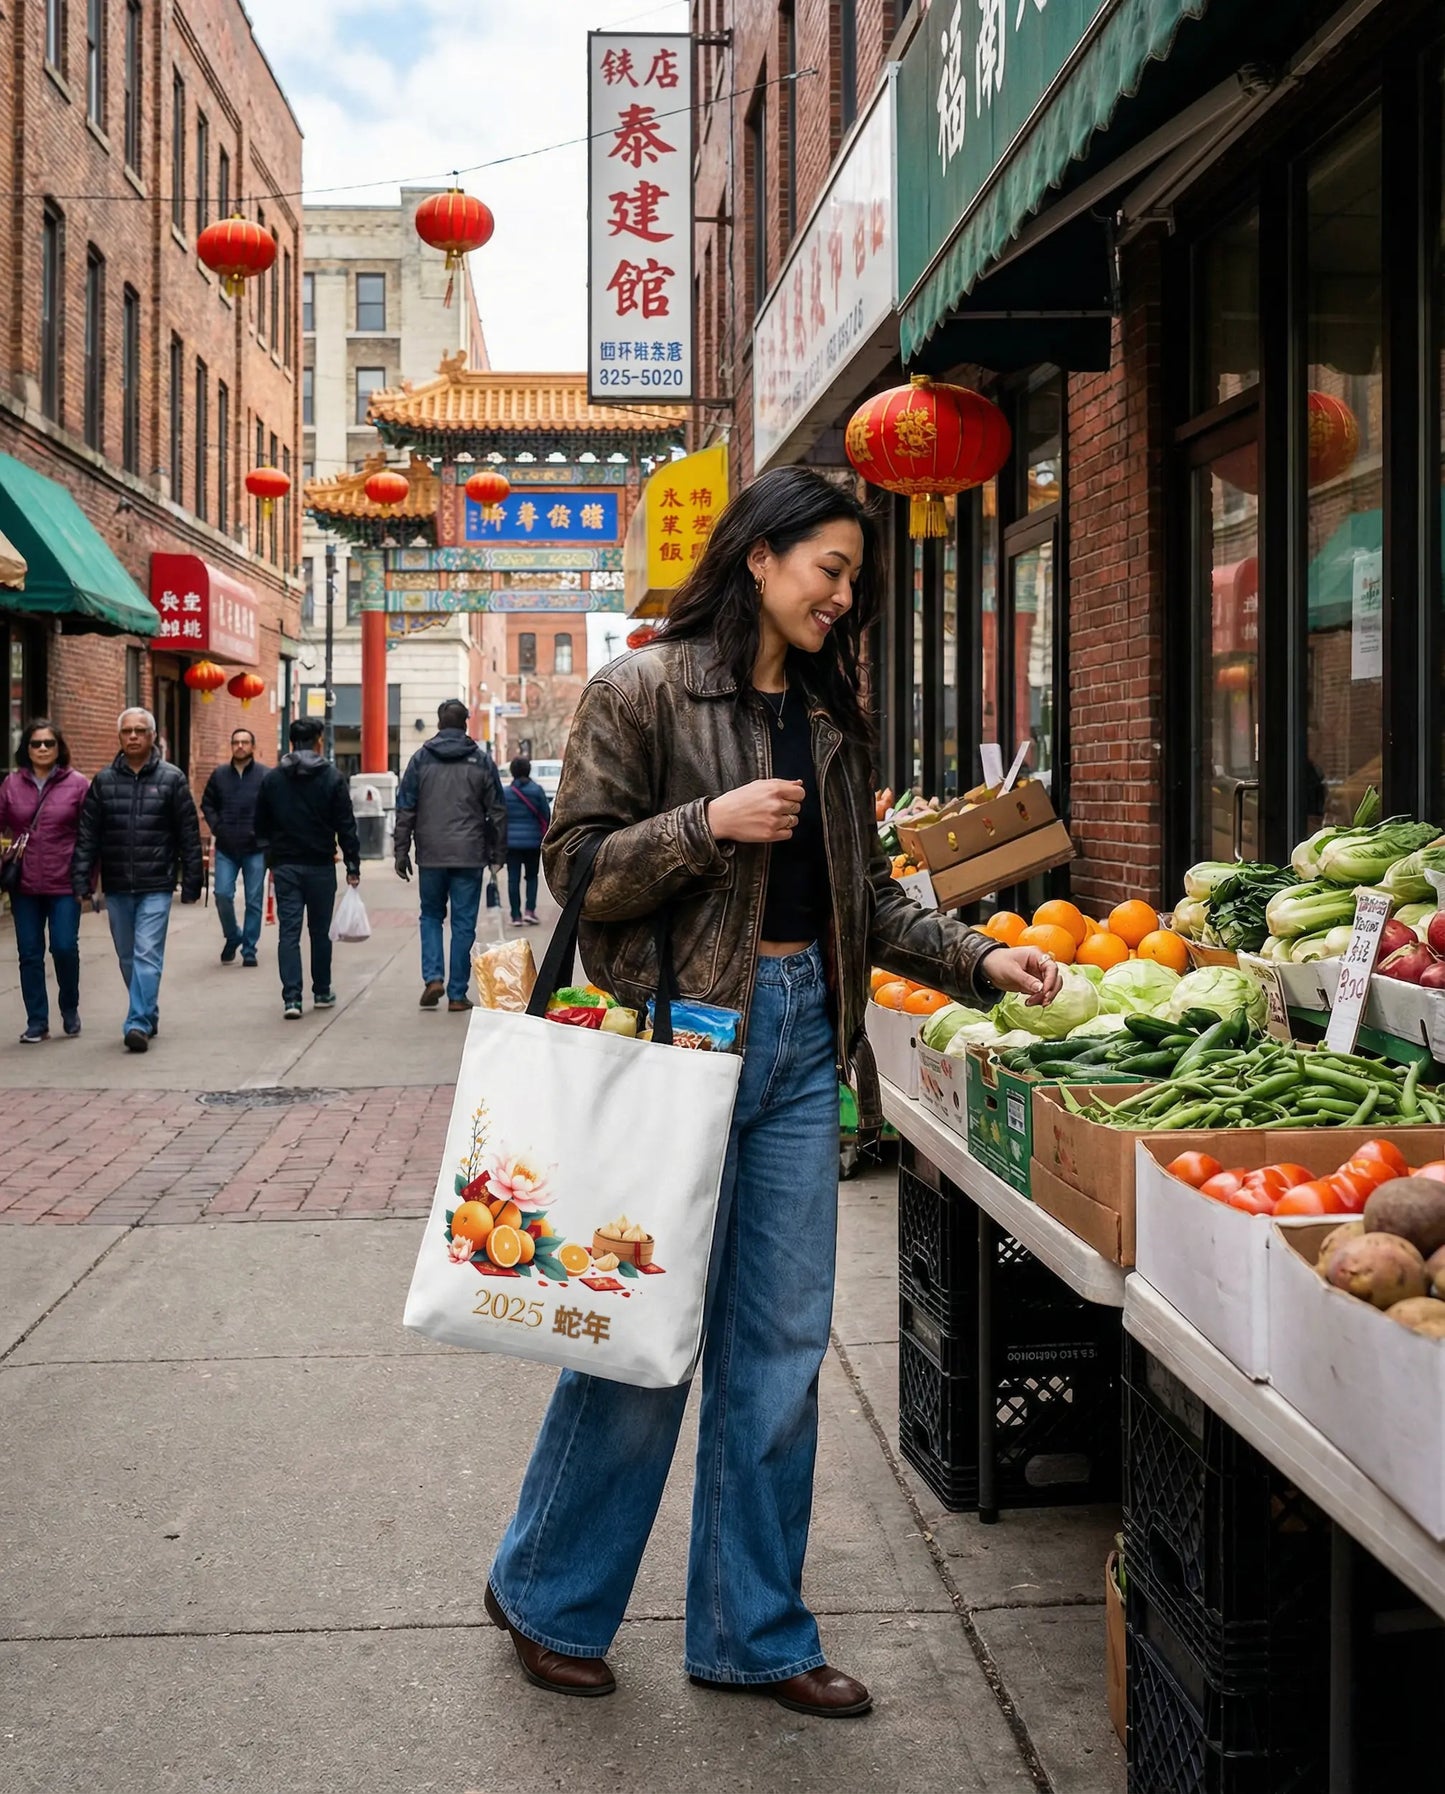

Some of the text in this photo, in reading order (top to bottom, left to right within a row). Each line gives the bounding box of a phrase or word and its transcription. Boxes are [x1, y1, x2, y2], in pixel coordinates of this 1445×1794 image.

[599, 368, 684, 387] 325-5020
[472, 1289, 545, 1328] 2025
[552, 1305, 612, 1345] 蛇年
